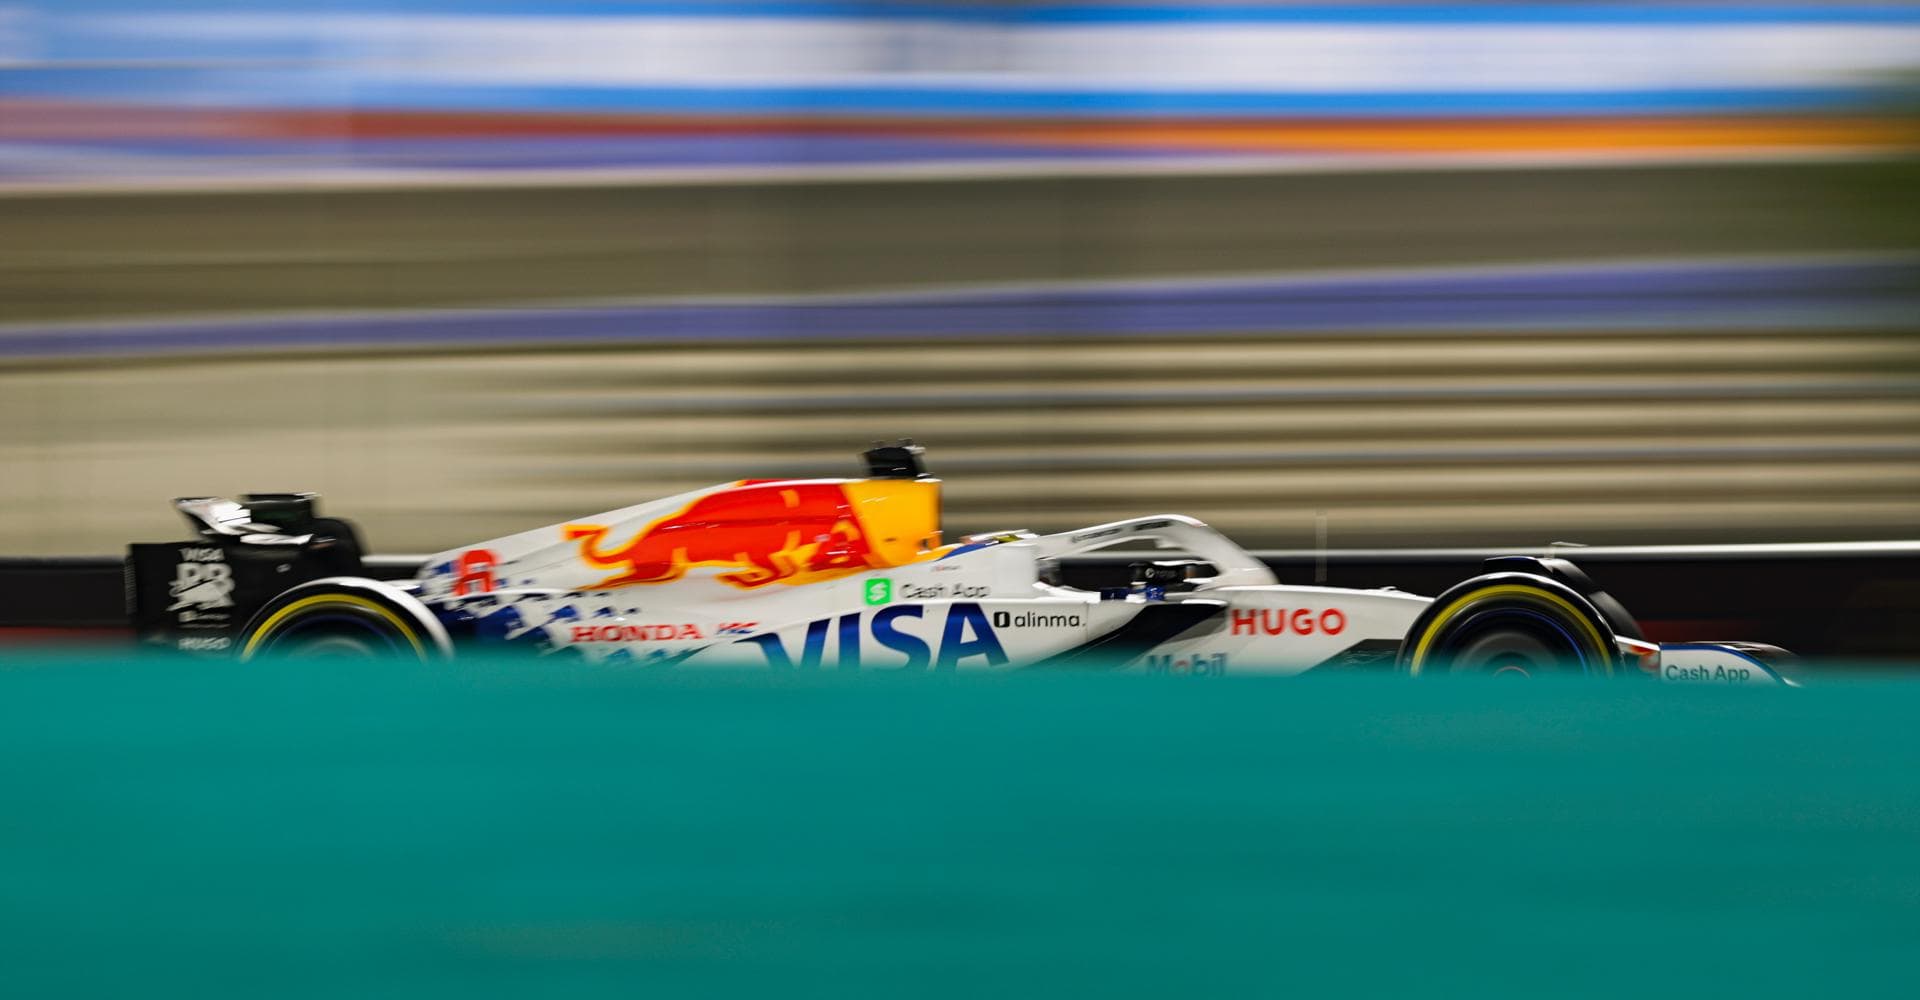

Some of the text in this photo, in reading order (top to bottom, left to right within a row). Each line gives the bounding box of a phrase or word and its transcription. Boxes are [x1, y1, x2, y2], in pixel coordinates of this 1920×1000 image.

[569, 624, 703, 643] HONDA
[1230, 608, 1346, 636] HUGO
[730, 602, 1010, 672] VISA
[1147, 653, 1228, 677] Mobil
[1665, 664, 1750, 684] Cash App
